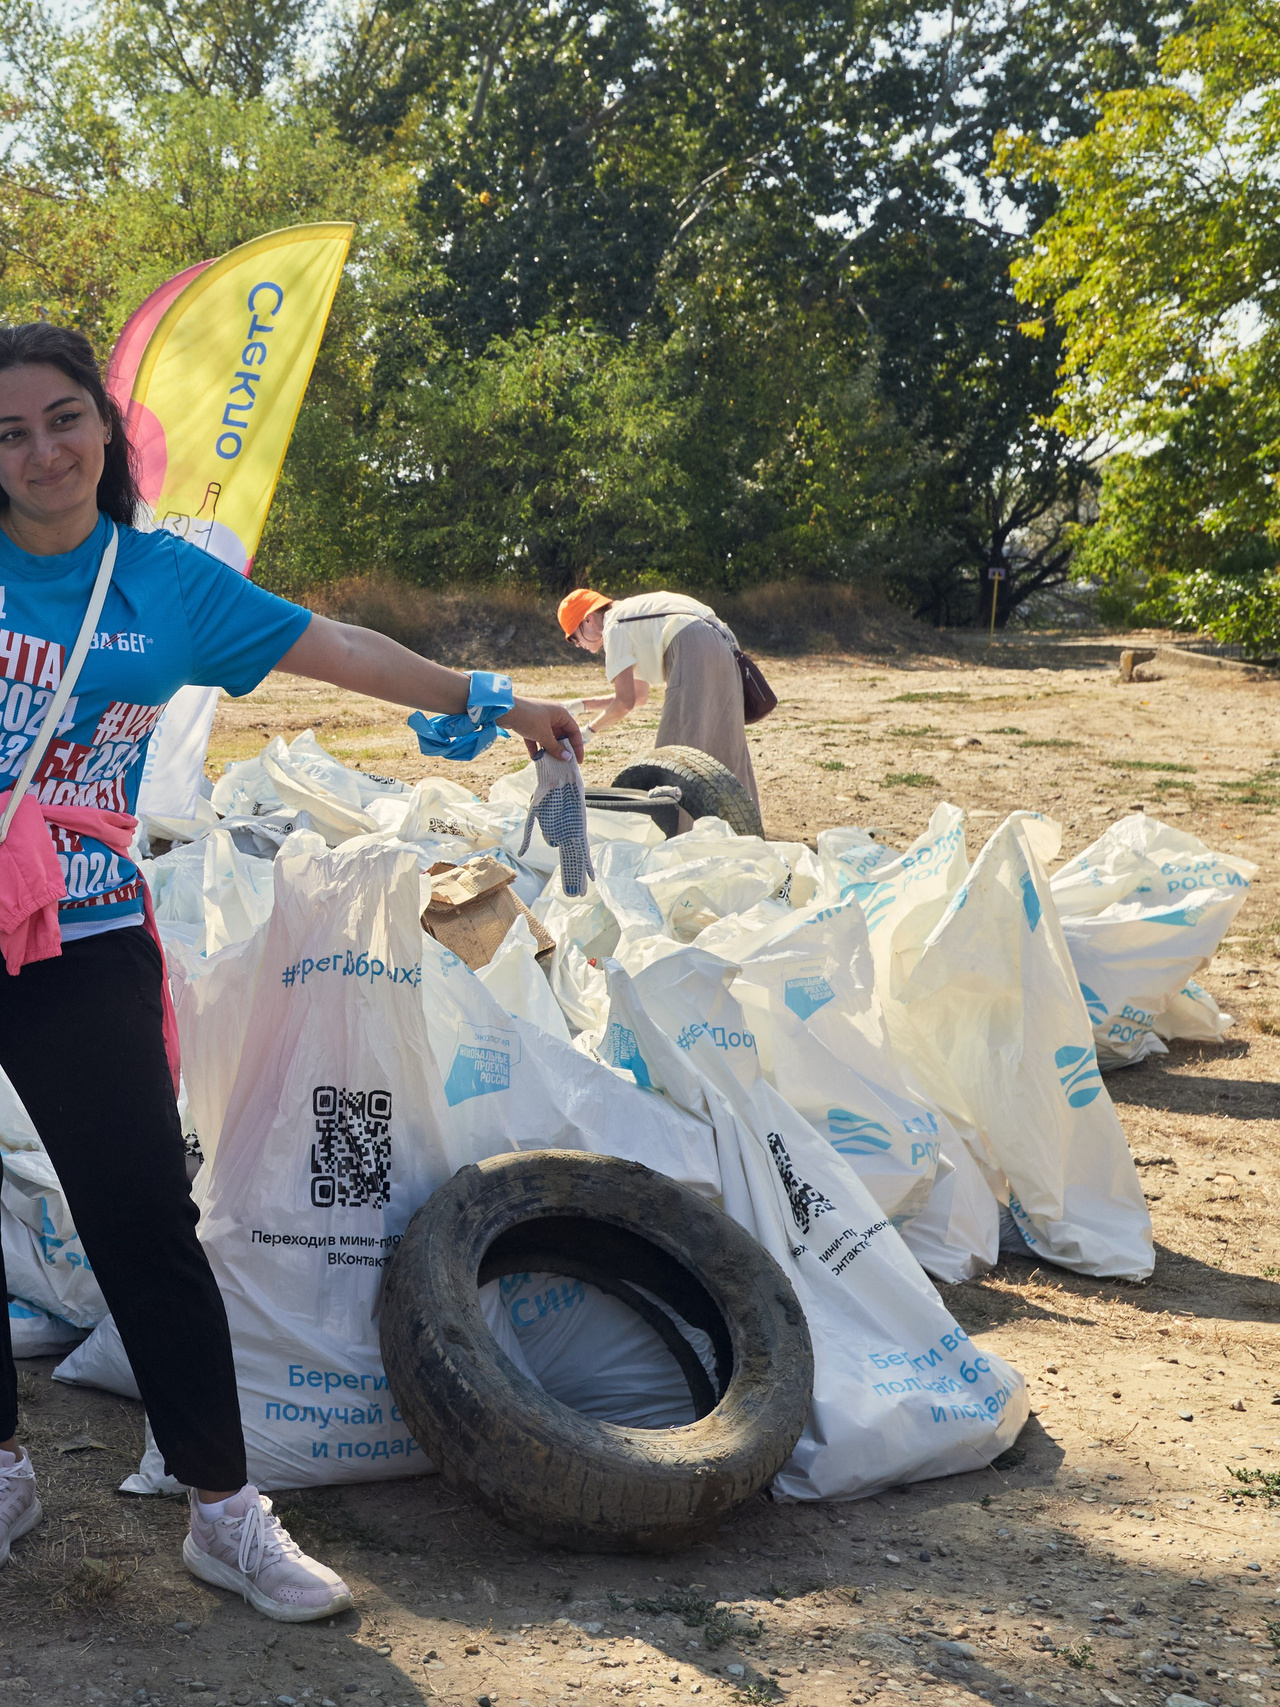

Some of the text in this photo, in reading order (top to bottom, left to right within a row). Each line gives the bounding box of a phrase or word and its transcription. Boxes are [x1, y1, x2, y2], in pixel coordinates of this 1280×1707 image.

[251, 1230, 326, 1247] Переходи
[327, 1236, 336, 1246] в
[265, 1402, 383, 1429] получай
[312, 1440, 328, 1459] и
